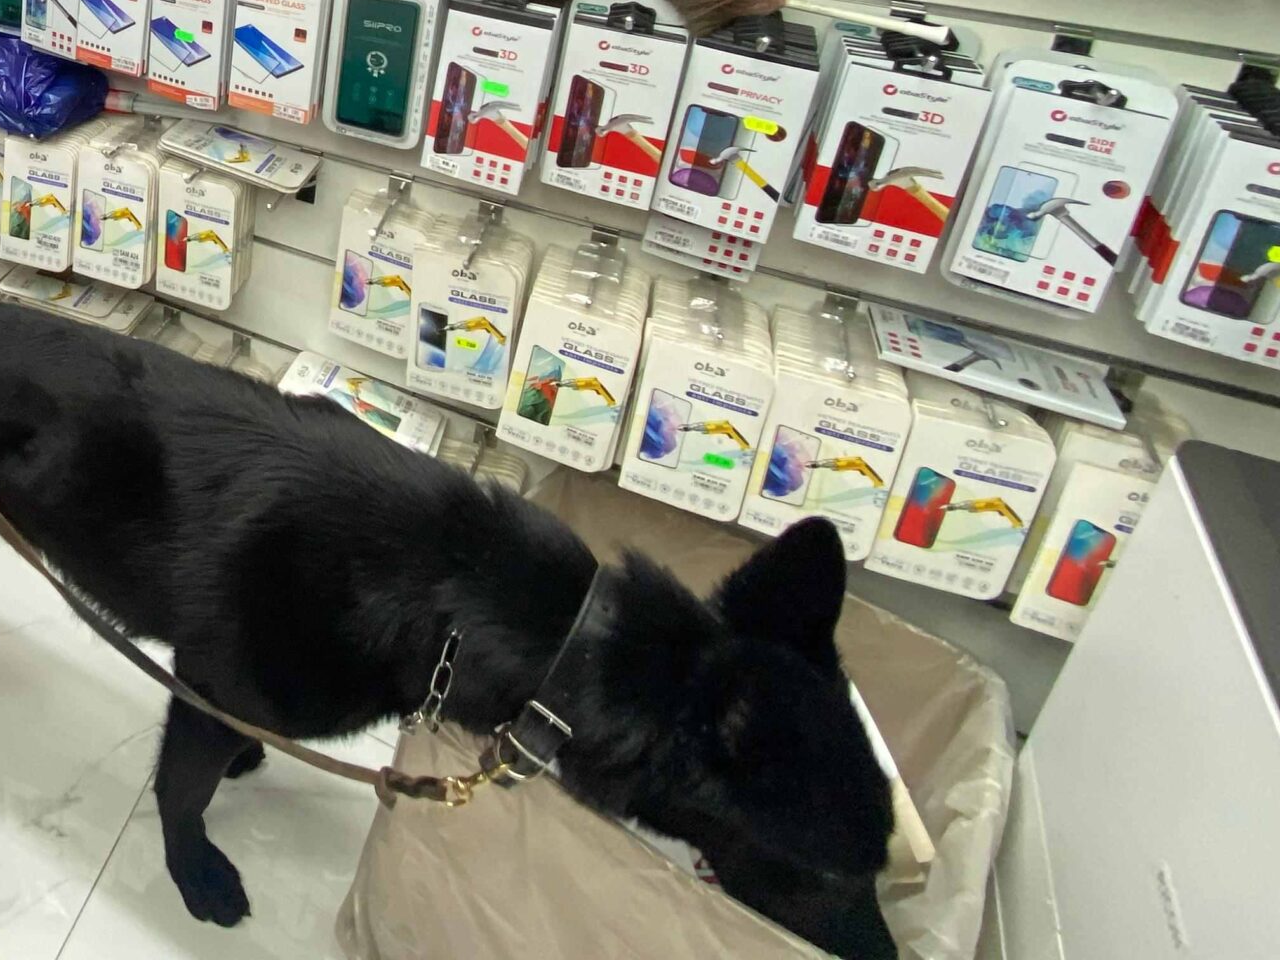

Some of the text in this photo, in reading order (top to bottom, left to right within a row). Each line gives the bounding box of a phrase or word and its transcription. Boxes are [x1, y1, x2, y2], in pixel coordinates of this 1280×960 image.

[280, 0, 306, 11] GLASS
[498, 49, 518, 61] 3D
[629, 62, 649, 76] 3D
[740, 89, 783, 105] PRIVACY
[919, 110, 945, 125] 3D
[1089, 137, 1116, 147] SIDE
[1087, 144, 1113, 155] GLUE
[29, 152, 48, 162] oba
[28, 169, 61, 181] GLASS
[104, 163, 122, 174] oba
[103, 180, 135, 194] GLASS
[186, 204, 220, 217] GLASS
[371, 245, 411, 264] GLASS
[451, 269, 477, 280] oba
[451, 289, 496, 305] GLASS
[568, 322, 596, 335] oba
[563, 342, 614, 363] GLASS
[694, 362, 726, 377] oba
[689, 383, 746, 406] GLASS
[823, 397, 858, 413] oba
[818, 418, 881, 441] GLASS
[966, 439, 1002, 453] oba
[959, 460, 1024, 480] GLASS
